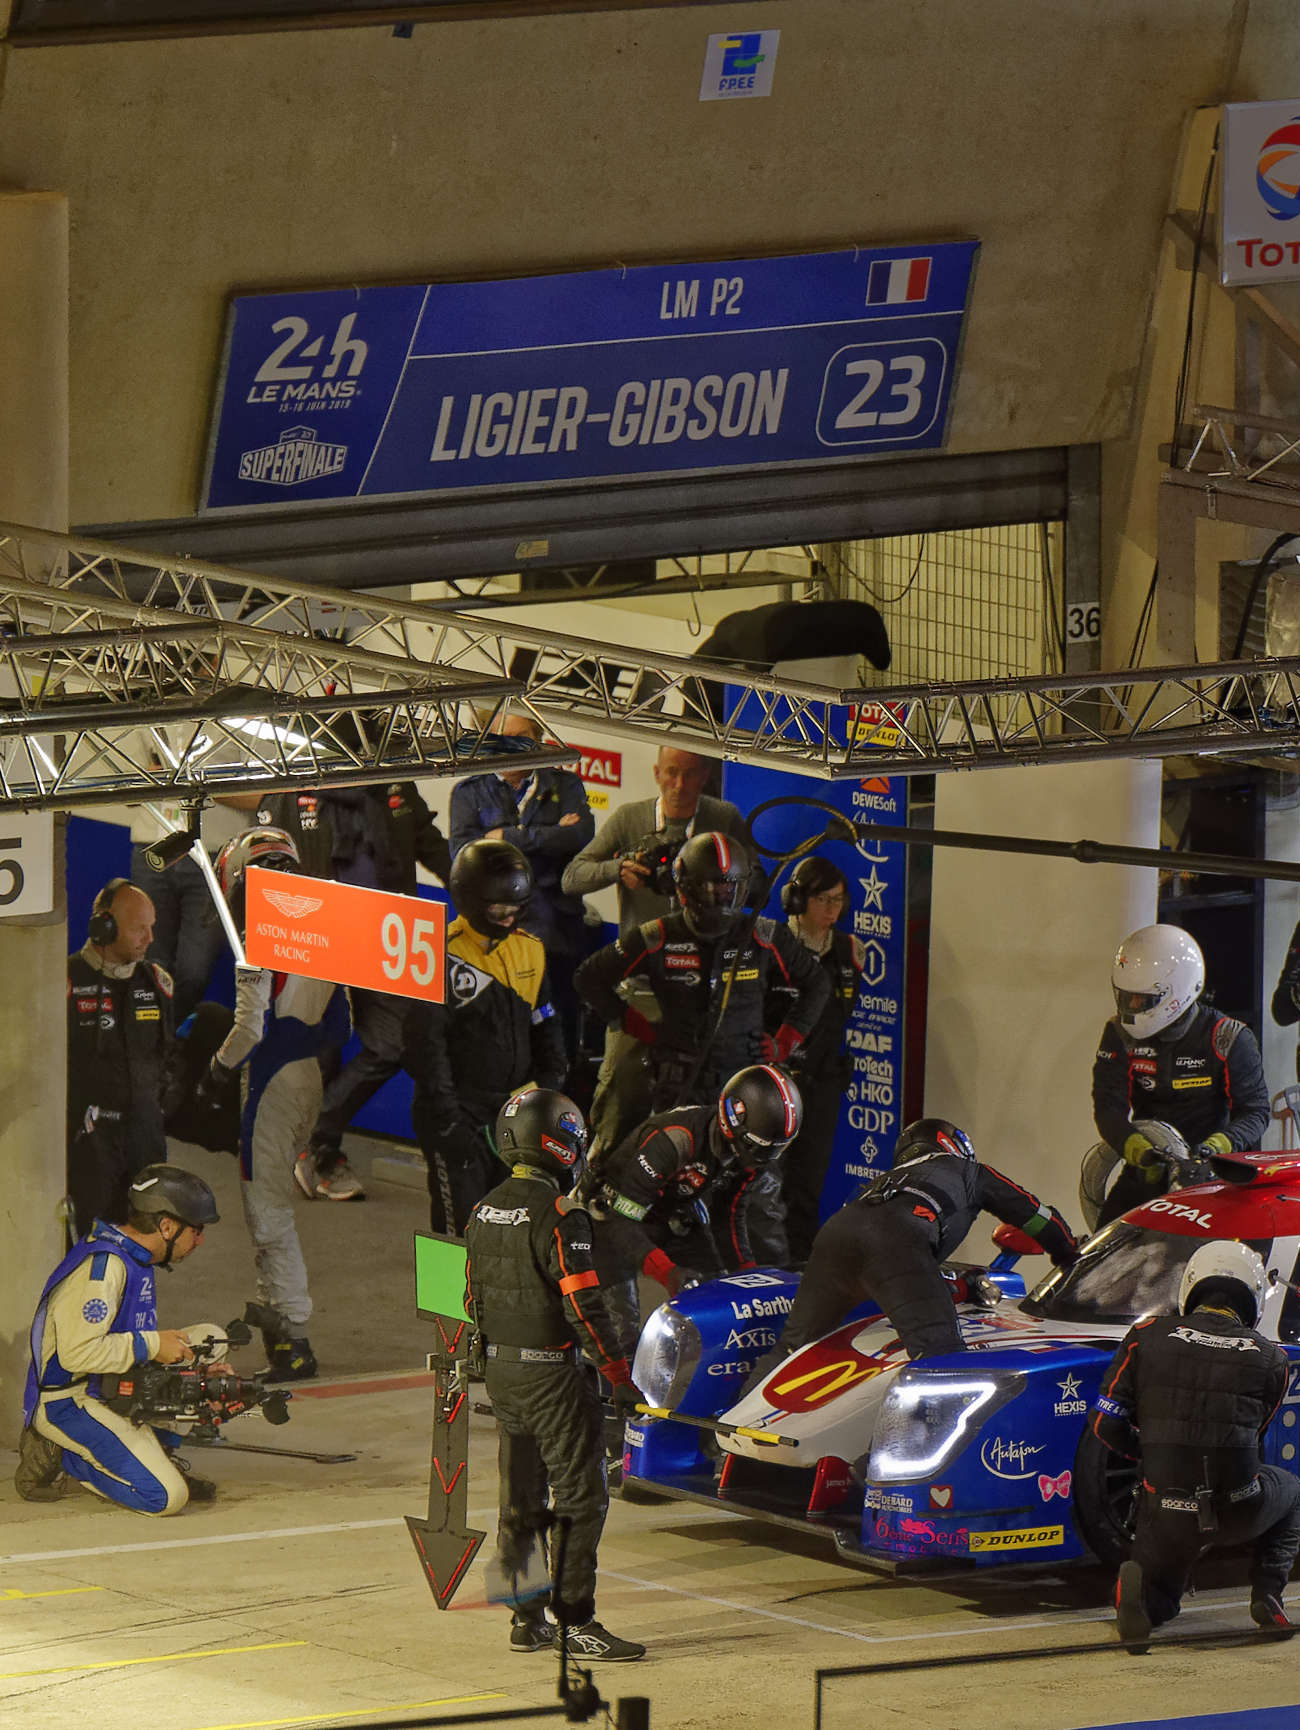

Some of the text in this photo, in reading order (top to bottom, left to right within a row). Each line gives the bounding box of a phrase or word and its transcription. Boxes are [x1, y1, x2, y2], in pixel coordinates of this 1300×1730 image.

[661, 276, 744, 320] LM P2
[254, 312, 368, 383] 24h
[246, 380, 357, 404] LE MANS
[833, 354, 926, 430] 23
[429, 367, 789, 463] LIGIER-GIBSON
[240, 441, 346, 484] SUPERFINALE
[1068, 607, 1102, 638] 36
[858, 726, 901, 744] DUNLO
[852, 791, 897, 814] DEWESoft
[853, 910, 892, 935] HEXIS
[256, 922, 329, 949] ASTON MARTIN
[272, 943, 311, 963] RACING
[380, 911, 437, 986] 95
[665, 956, 699, 968] TOTAL
[854, 1056, 893, 1078] roTech
[861, 1081, 893, 1106] HKO
[848, 1105, 894, 1134] GDP
[845, 1162, 888, 1180] IMBRET
[1140, 1198, 1214, 1231] TOTAL
[731, 1295, 796, 1320] La Sarth
[723, 1327, 777, 1350] Axis
[1053, 1399, 1087, 1414] HEXIS
[1097, 1397, 1113, 1412] TYRE
[1161, 1498, 1199, 1511] sparco
[987, 1529, 1061, 1547] DUNLOP
